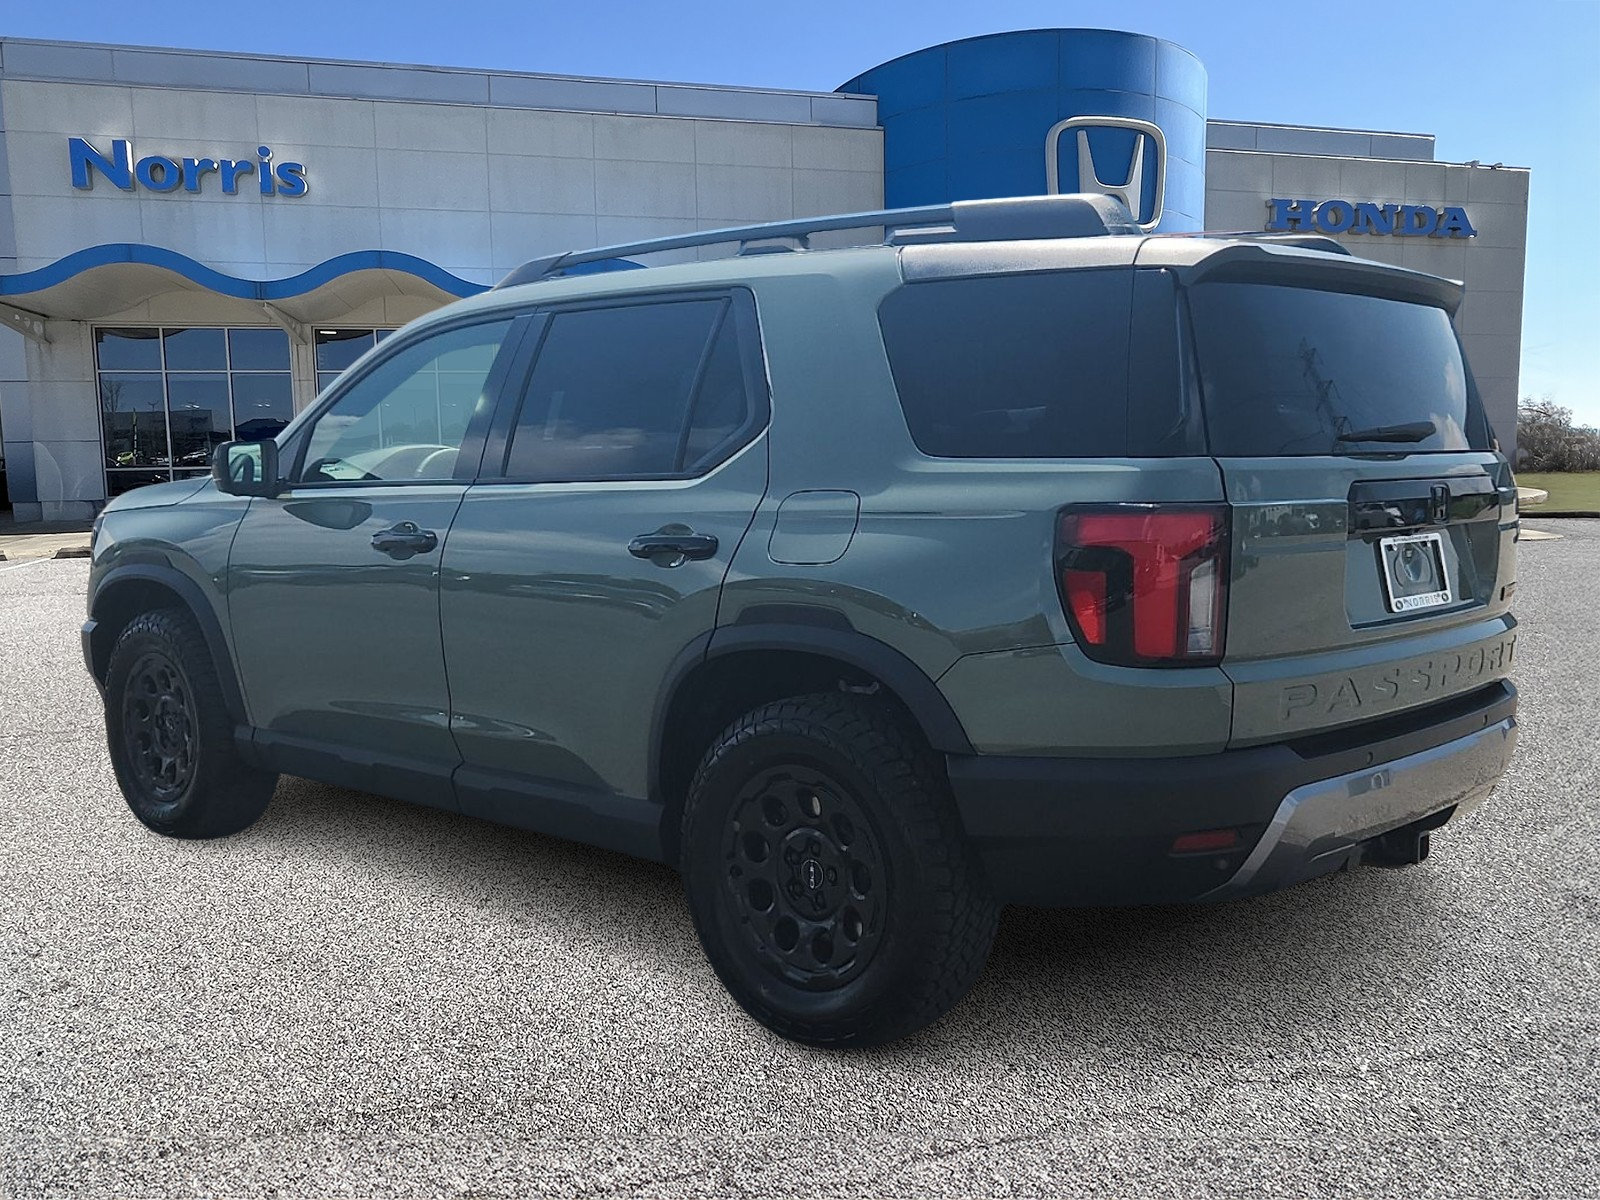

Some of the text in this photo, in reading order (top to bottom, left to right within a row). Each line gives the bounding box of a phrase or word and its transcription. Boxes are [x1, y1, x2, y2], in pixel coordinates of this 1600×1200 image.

[68, 137, 309, 197] Norris
[1265, 198, 1477, 239] HONDA
[1280, 634, 1517, 722] PASSPORT
